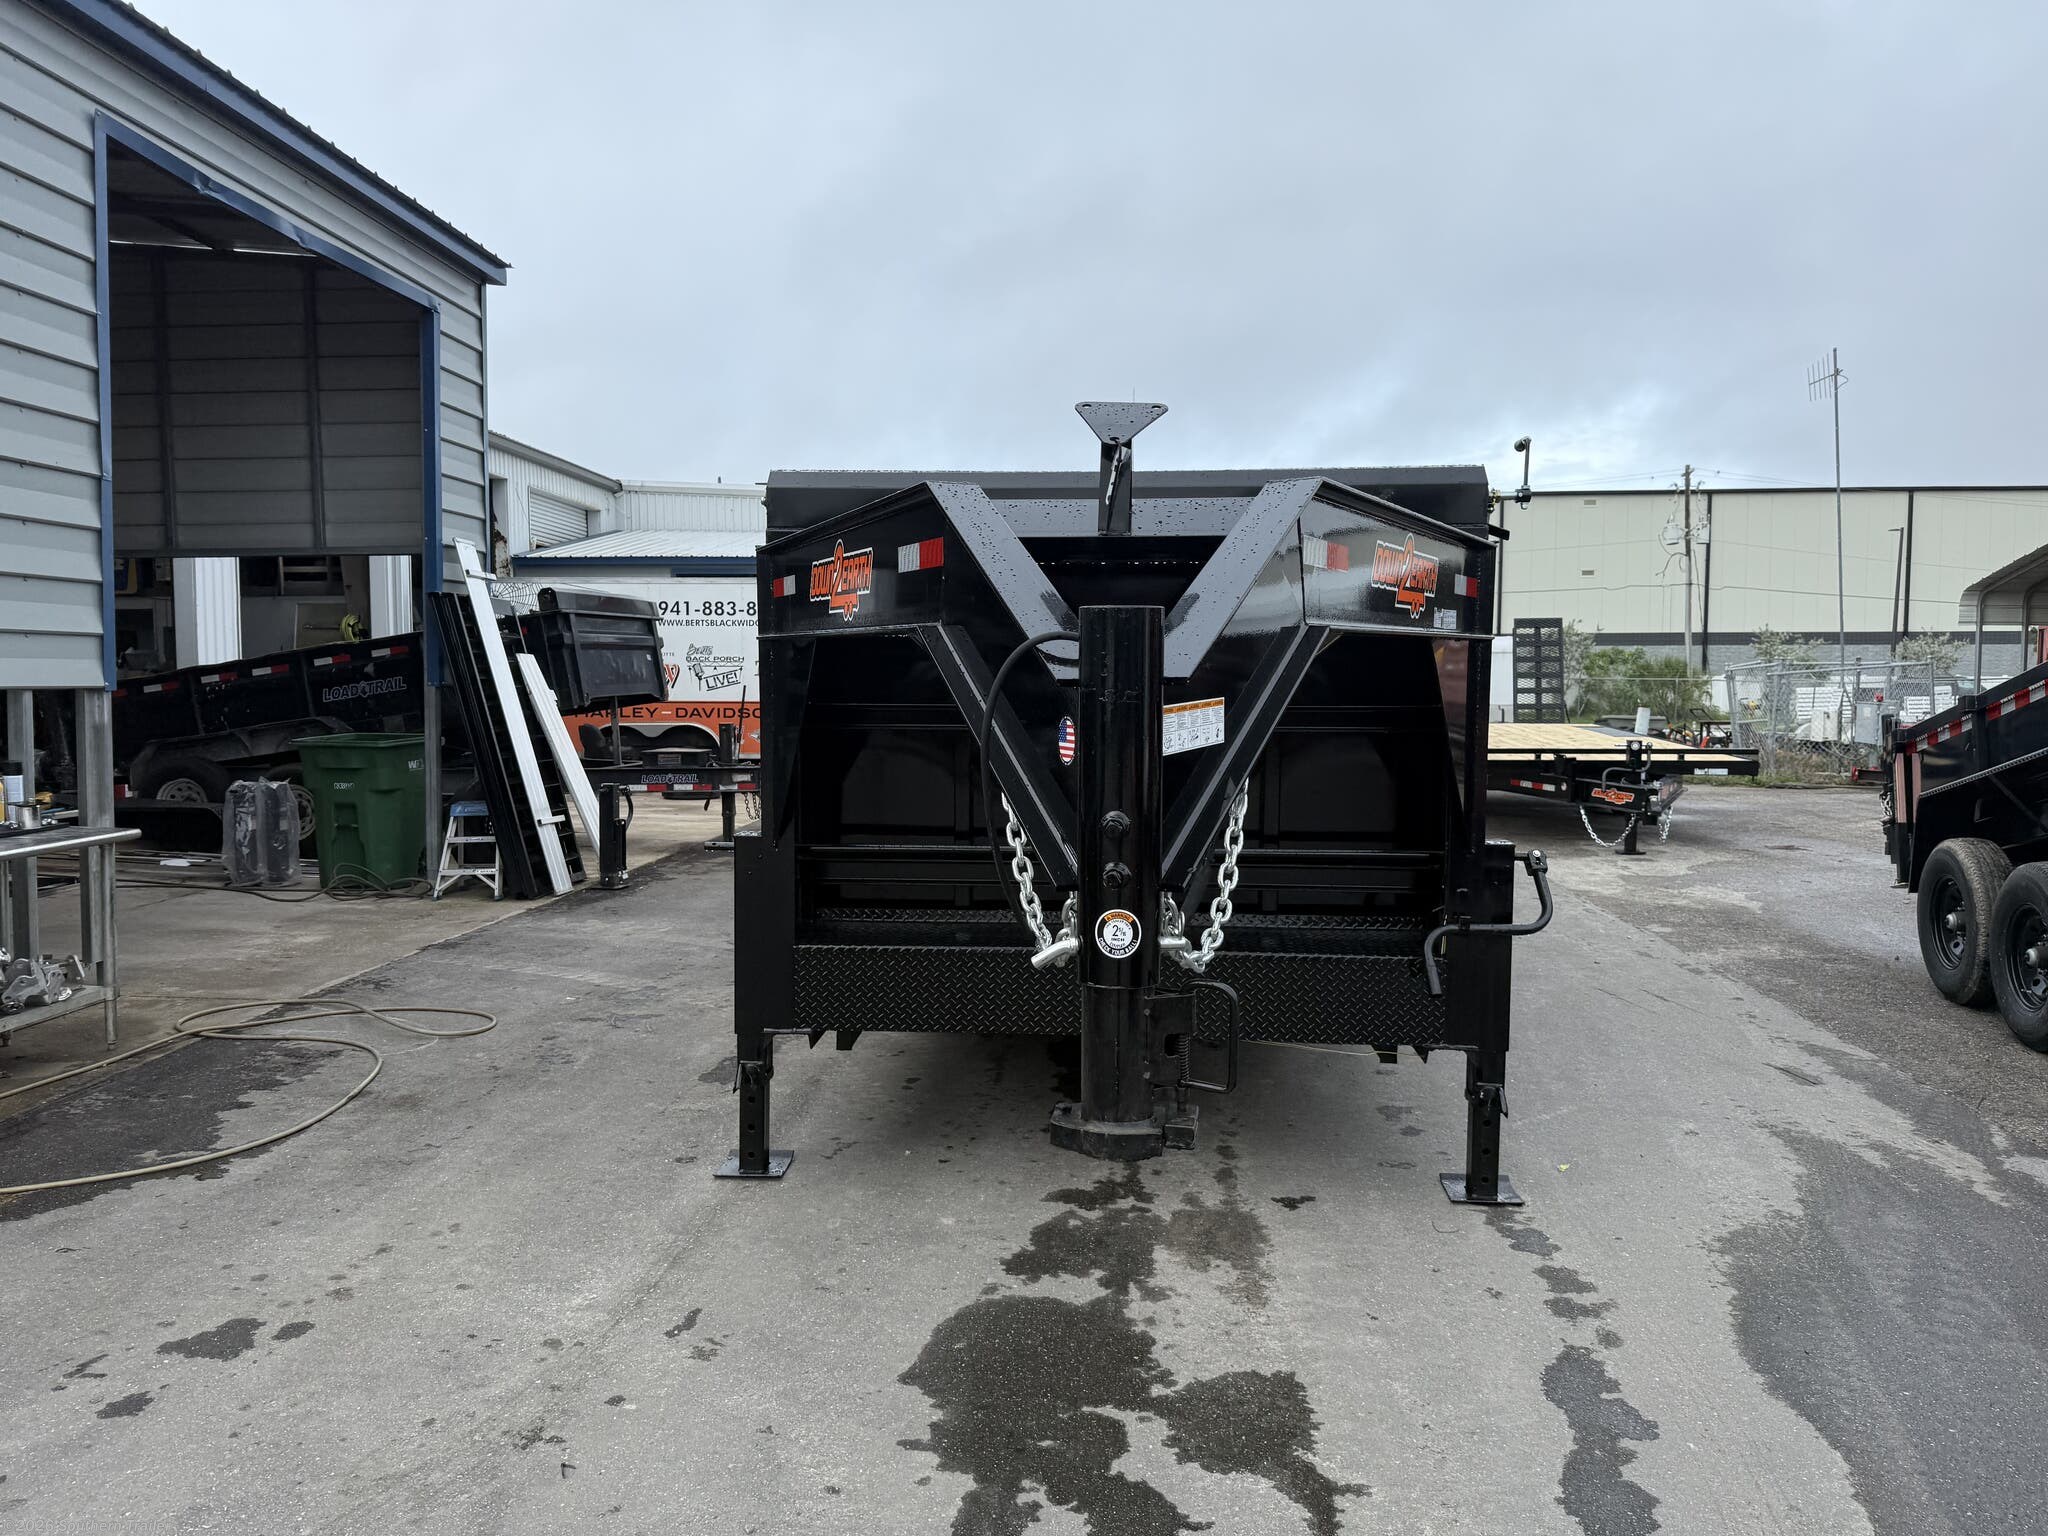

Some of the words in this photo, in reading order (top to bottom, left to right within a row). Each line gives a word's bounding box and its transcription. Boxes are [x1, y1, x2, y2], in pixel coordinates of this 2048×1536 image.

[658, 601, 757, 616] 941-883-8
[705, 671, 739, 689] LIVE!
[323, 684, 361, 702] LOAD
[366, 677, 407, 696] TRAIL
[641, 774, 668, 784] LOAD
[671, 774, 699, 783] TRAIL
[1112, 924, 1119, 937] 2
